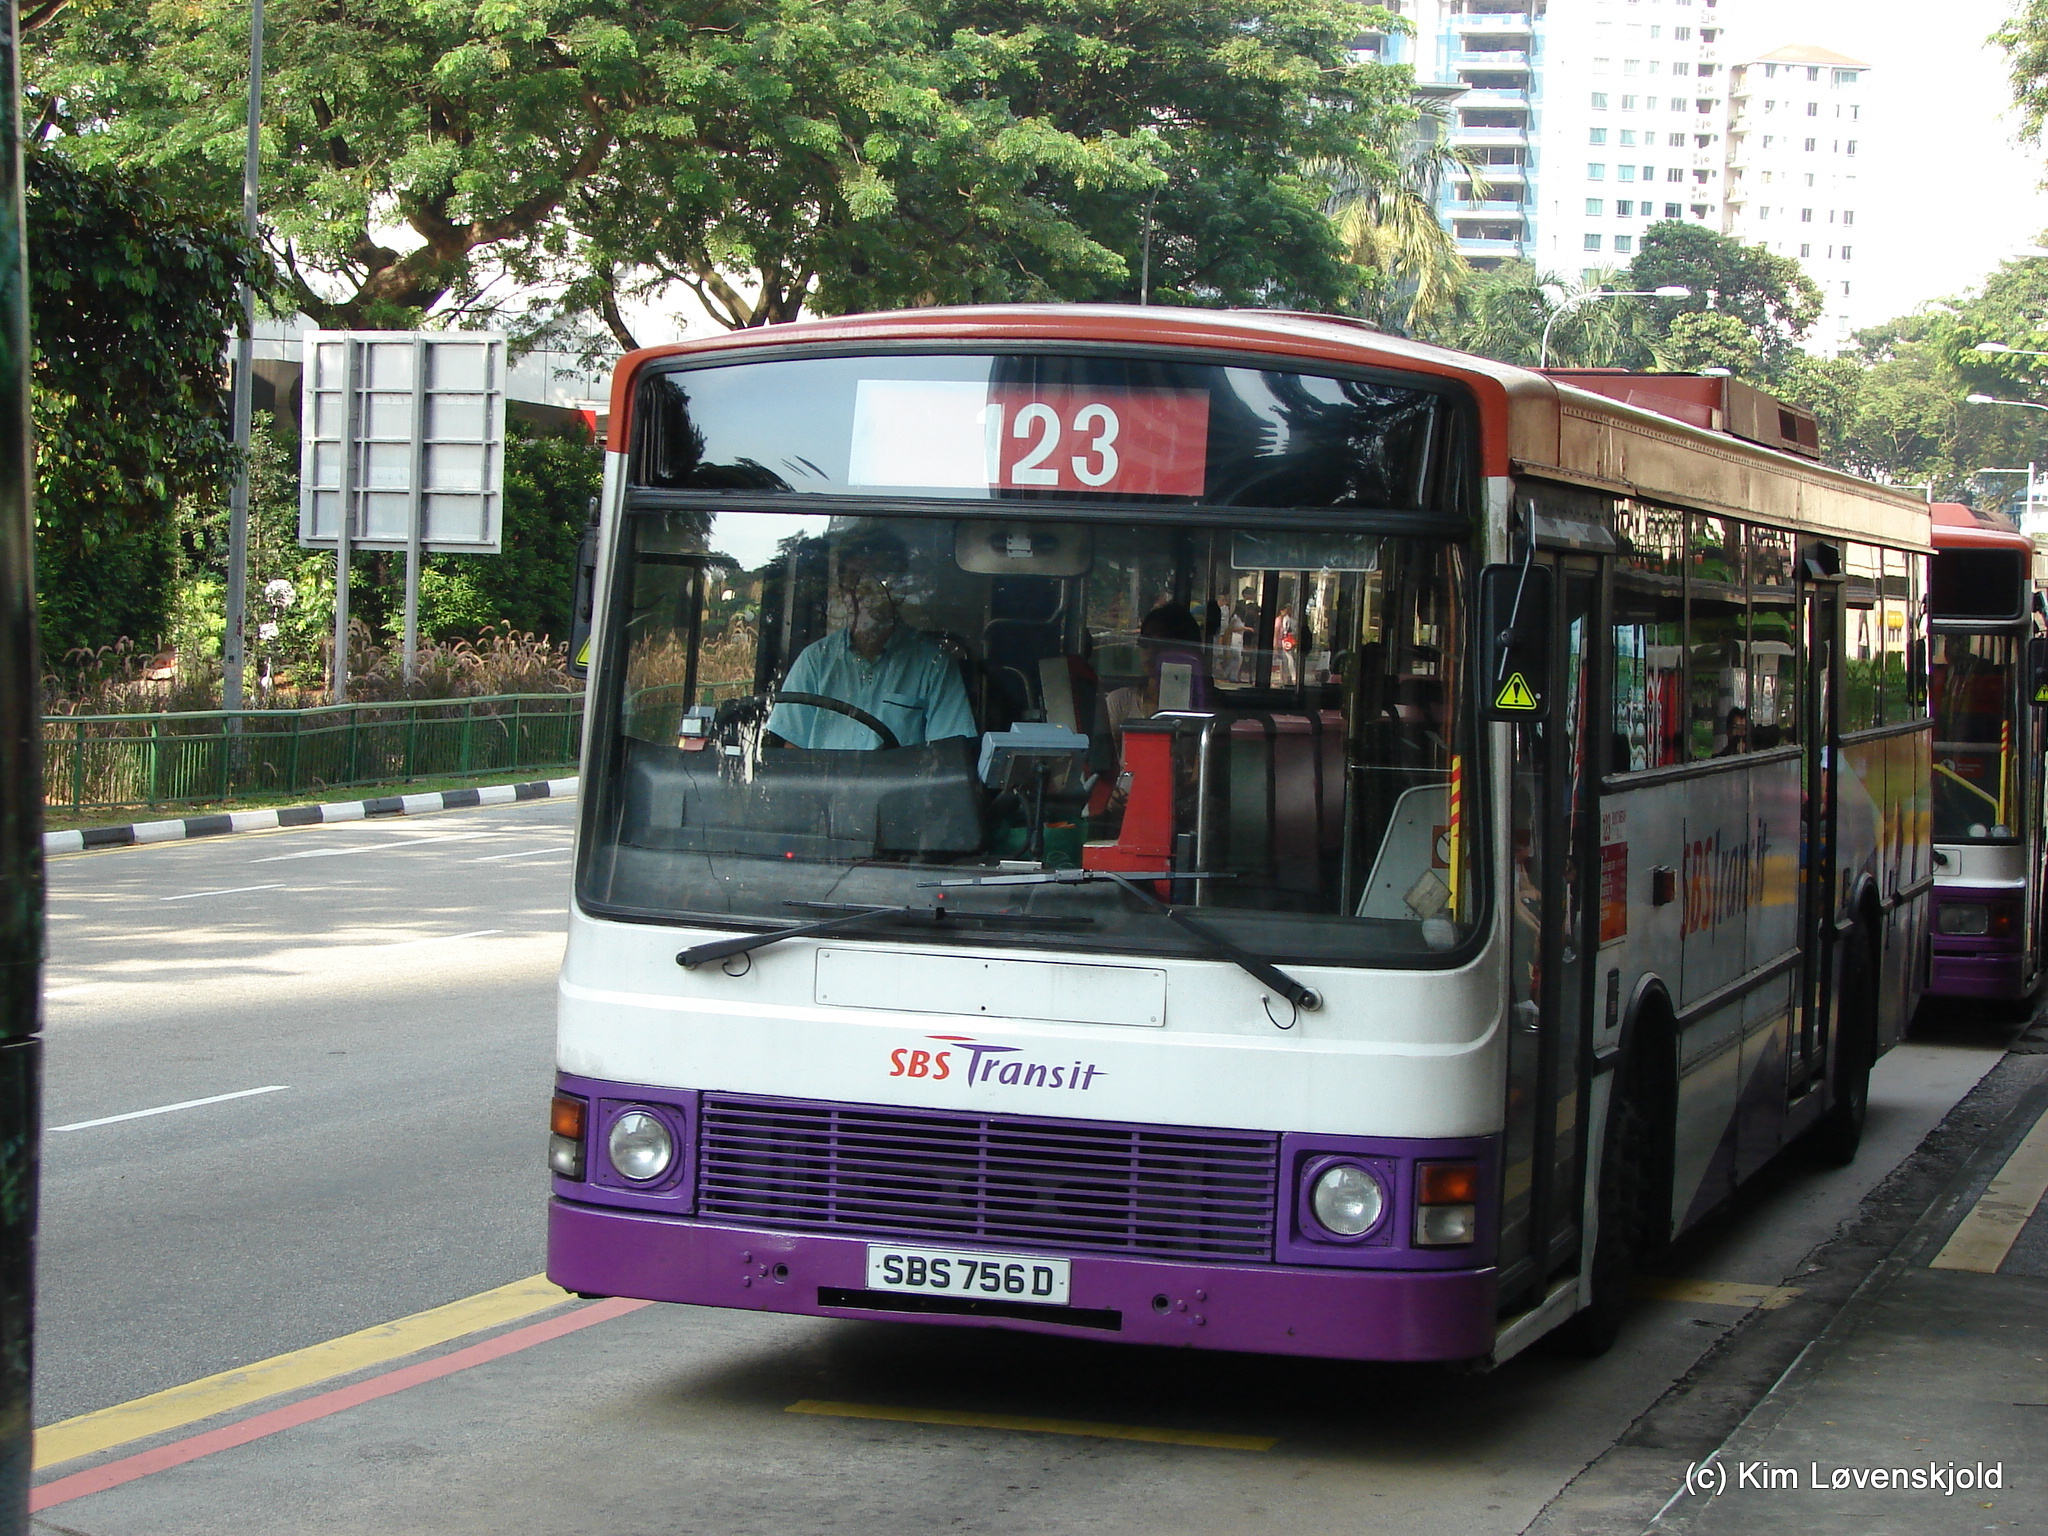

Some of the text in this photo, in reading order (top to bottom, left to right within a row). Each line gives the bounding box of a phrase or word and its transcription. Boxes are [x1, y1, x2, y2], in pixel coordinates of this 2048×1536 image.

[1679, 835, 1713, 942] SBS
[889, 1042, 1110, 1091] SBS Transit
